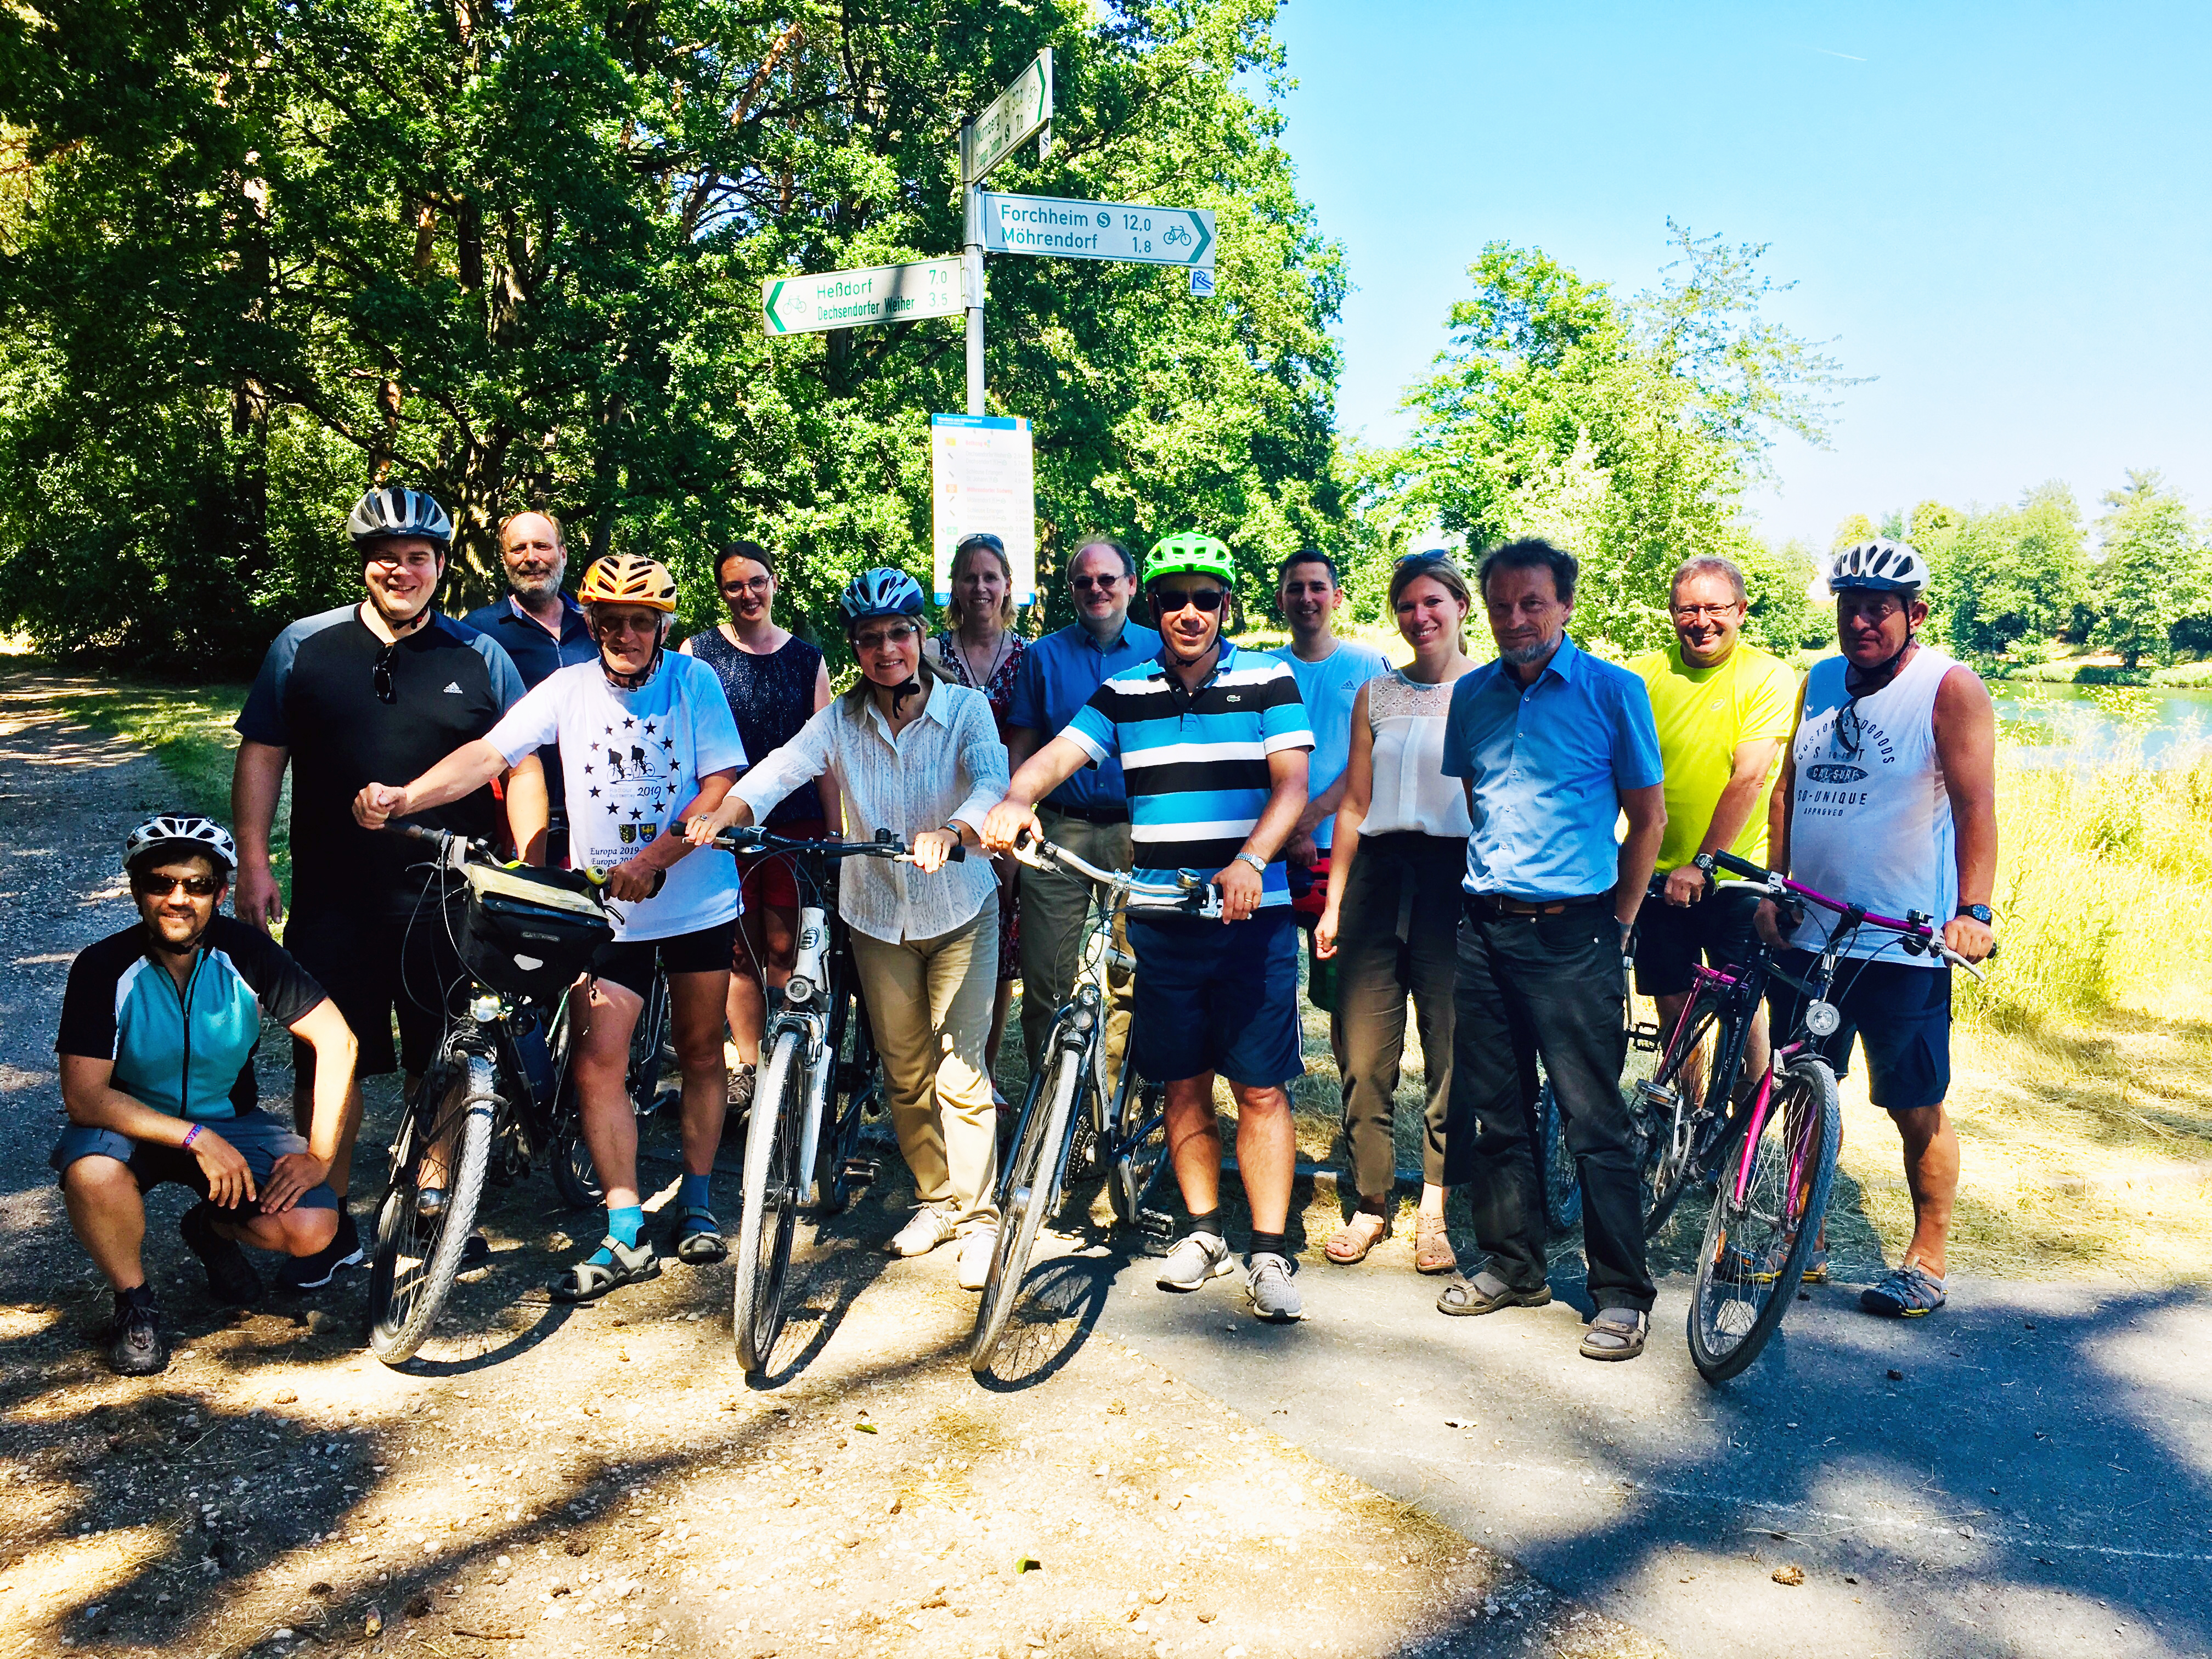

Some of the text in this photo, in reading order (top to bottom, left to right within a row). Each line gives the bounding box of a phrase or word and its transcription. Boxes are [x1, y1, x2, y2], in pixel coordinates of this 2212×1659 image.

[976, 113, 1000, 146] Nürnberg
[1001, 204, 1088, 227] Forchheim
[1124, 214, 1151, 232] 12,0
[1002, 227, 1152, 253] Möhrendorf 1,8
[817, 269, 947, 300] Heßdorf 7,0
[817, 292, 947, 321] Dechsendorfer Weiher 3,5
[1813, 768, 1858, 781] CAL SURF
[637, 786, 661, 800] 2019
[1797, 789, 1867, 805] SO-UNIQUE
[1803, 808, 1843, 816] APPROVED
[590, 847, 617, 857] Europa
[591, 857, 617, 867] Europa
